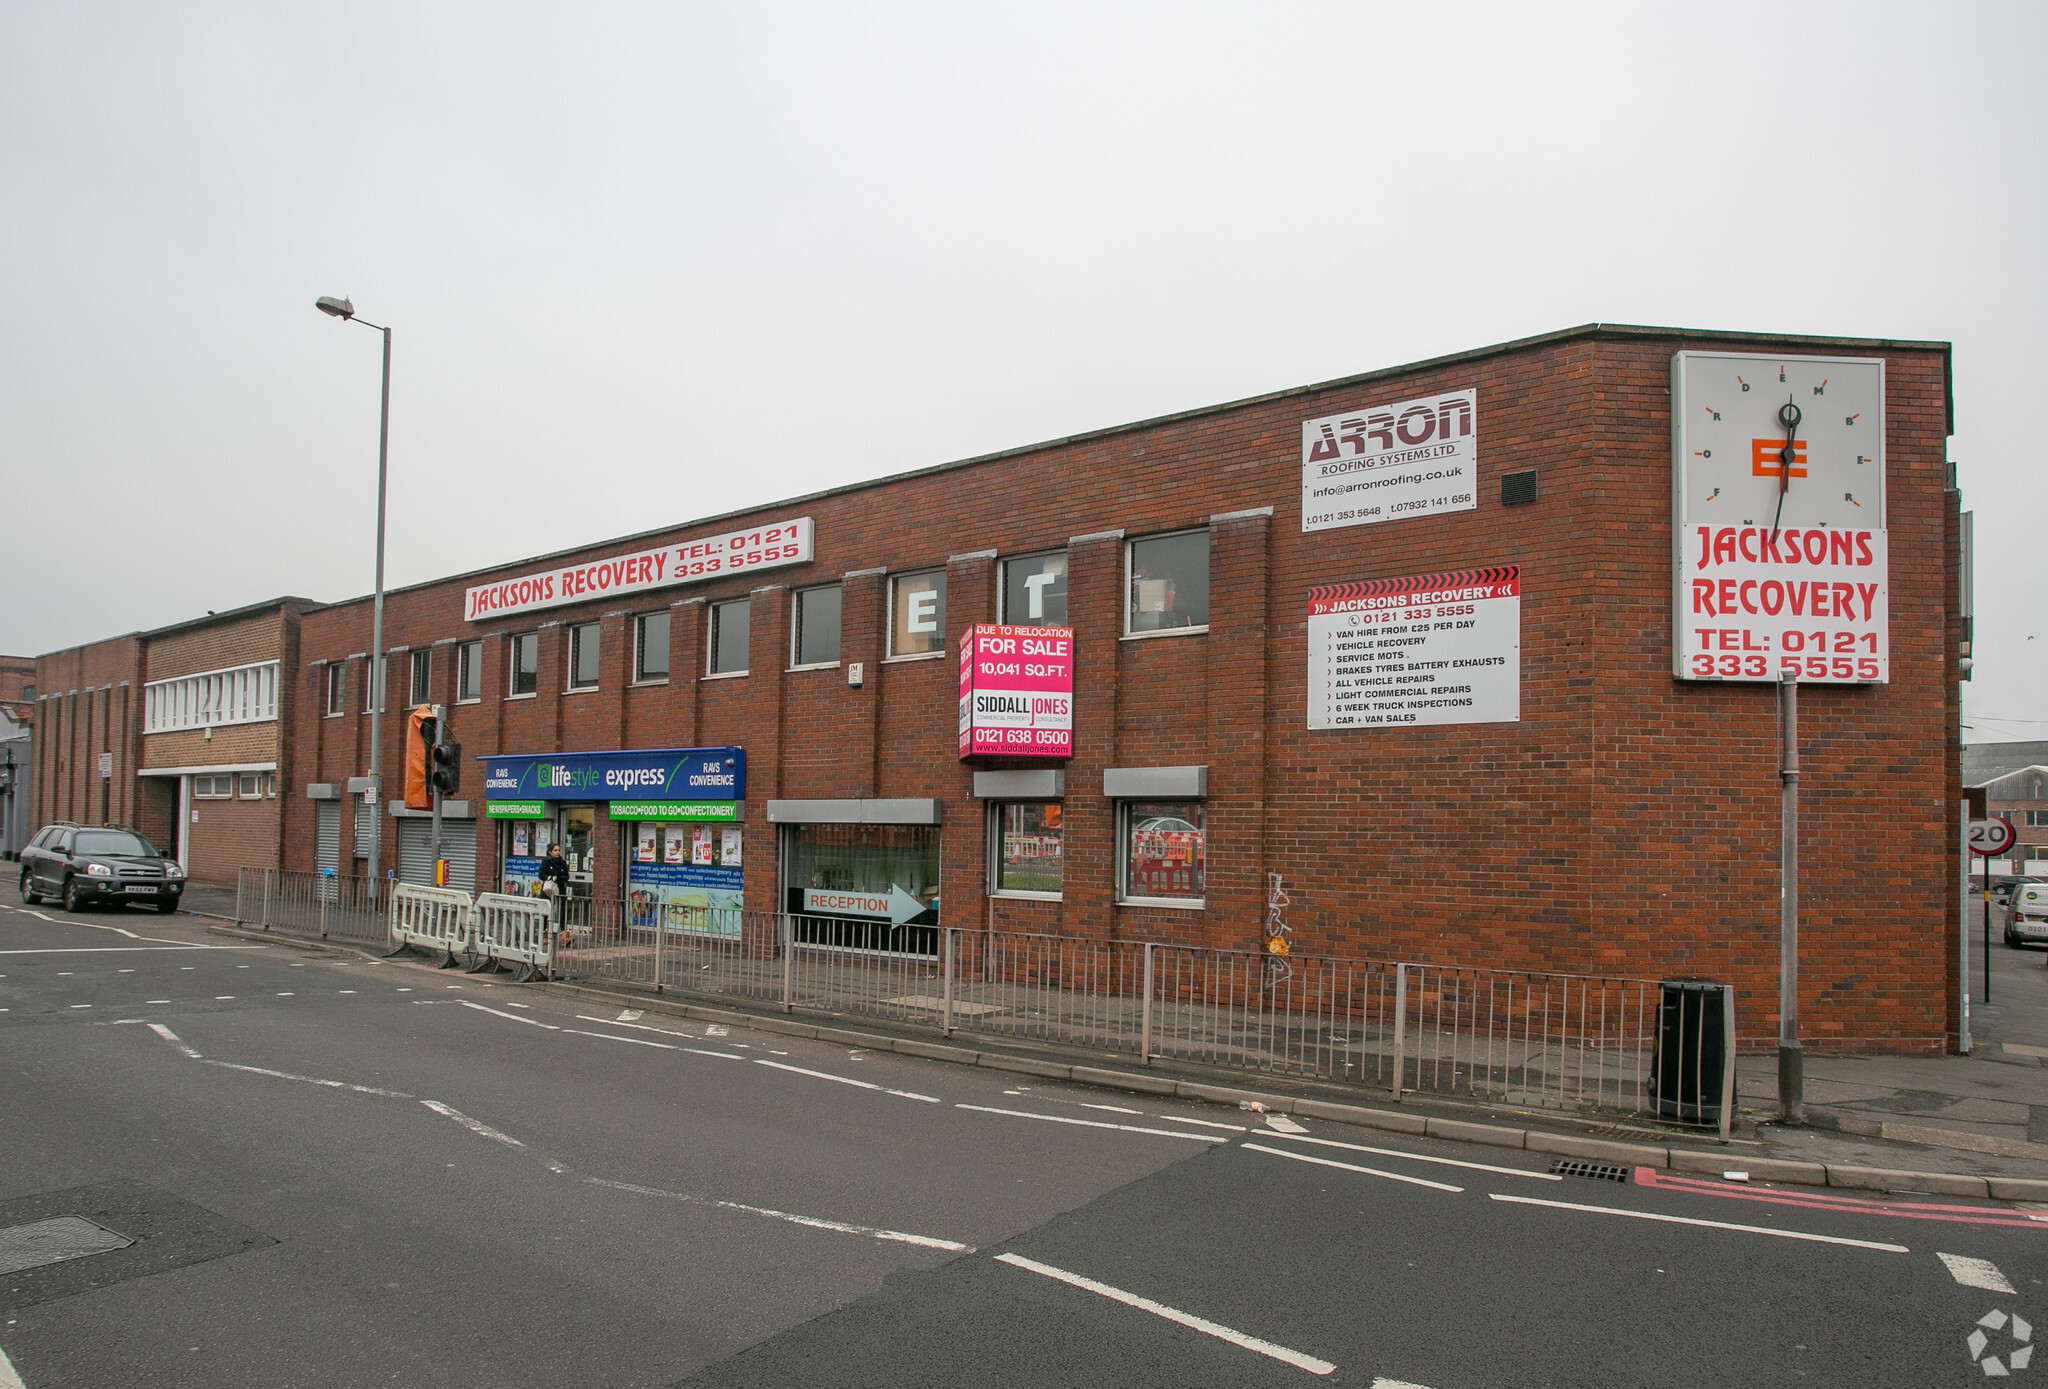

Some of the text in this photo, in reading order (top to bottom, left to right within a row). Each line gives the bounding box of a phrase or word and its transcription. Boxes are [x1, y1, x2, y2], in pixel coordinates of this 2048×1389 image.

[1321, 444, 1455, 475] ROOFING SYSTEMS LTD
[1313, 466, 1462, 498] info@arronroofing.co.uk
[1306, 493, 1471, 525] t.0121 353 5648 t.07932 141 656
[1696, 526, 1874, 571] JACKSONS
[674, 543, 799, 578] 333 5555
[470, 525, 797, 619] JACKSONS RECOVERY TEL: 0121
[1329, 585, 1494, 614] JACKSONS RECOVERY
[1692, 577, 1879, 623] RECOVERY
[1363, 604, 1475, 624] 0121 333 5555
[976, 625, 1073, 638] DUE TO RELOCATION
[1336, 620, 1476, 639] VAN HIRE FROM £25 PER DAY
[979, 638, 1016, 655] FOR
[1022, 639, 1068, 657] SALE
[1336, 637, 1426, 651] VEHICLE RECOVERY
[1694, 628, 1877, 654] TEL: 0121
[1336, 651, 1404, 663] SERVICE MOTS
[1336, 656, 1505, 676] BRAKES TYRES BATTERY EXHAUSTS
[1691, 654, 1880, 679] 333 5555
[979, 662, 1020, 676] 10,041
[1335, 674, 1436, 688] ALL VEHICLE REPAIRS
[1335, 685, 1472, 700] LIGHT COMMERCIAL REPAIRS
[977, 696, 1030, 714] SIDDALL
[1029, 697, 1068, 726] JONES
[1335, 698, 1473, 712] 6 WEEK TRUCK INSPECTIONS
[1335, 716, 1354, 725] CAR
[1364, 715, 1383, 723] VAN
[1386, 713, 1417, 723] SALES
[975, 729, 1003, 743] 0121
[1006, 729, 1032, 744] 638
[1036, 731, 1069, 745] 0500
[976, 744, 1068, 755] www.siddalljones.com
[486, 778, 518, 789] CONVENIENCE
[605, 766, 665, 791] express
[689, 774, 734, 787] CONVENIENCE
[658, 805, 668, 815] TO
[1969, 825, 2006, 843] 20
[810, 894, 888, 911] RECEPTION
